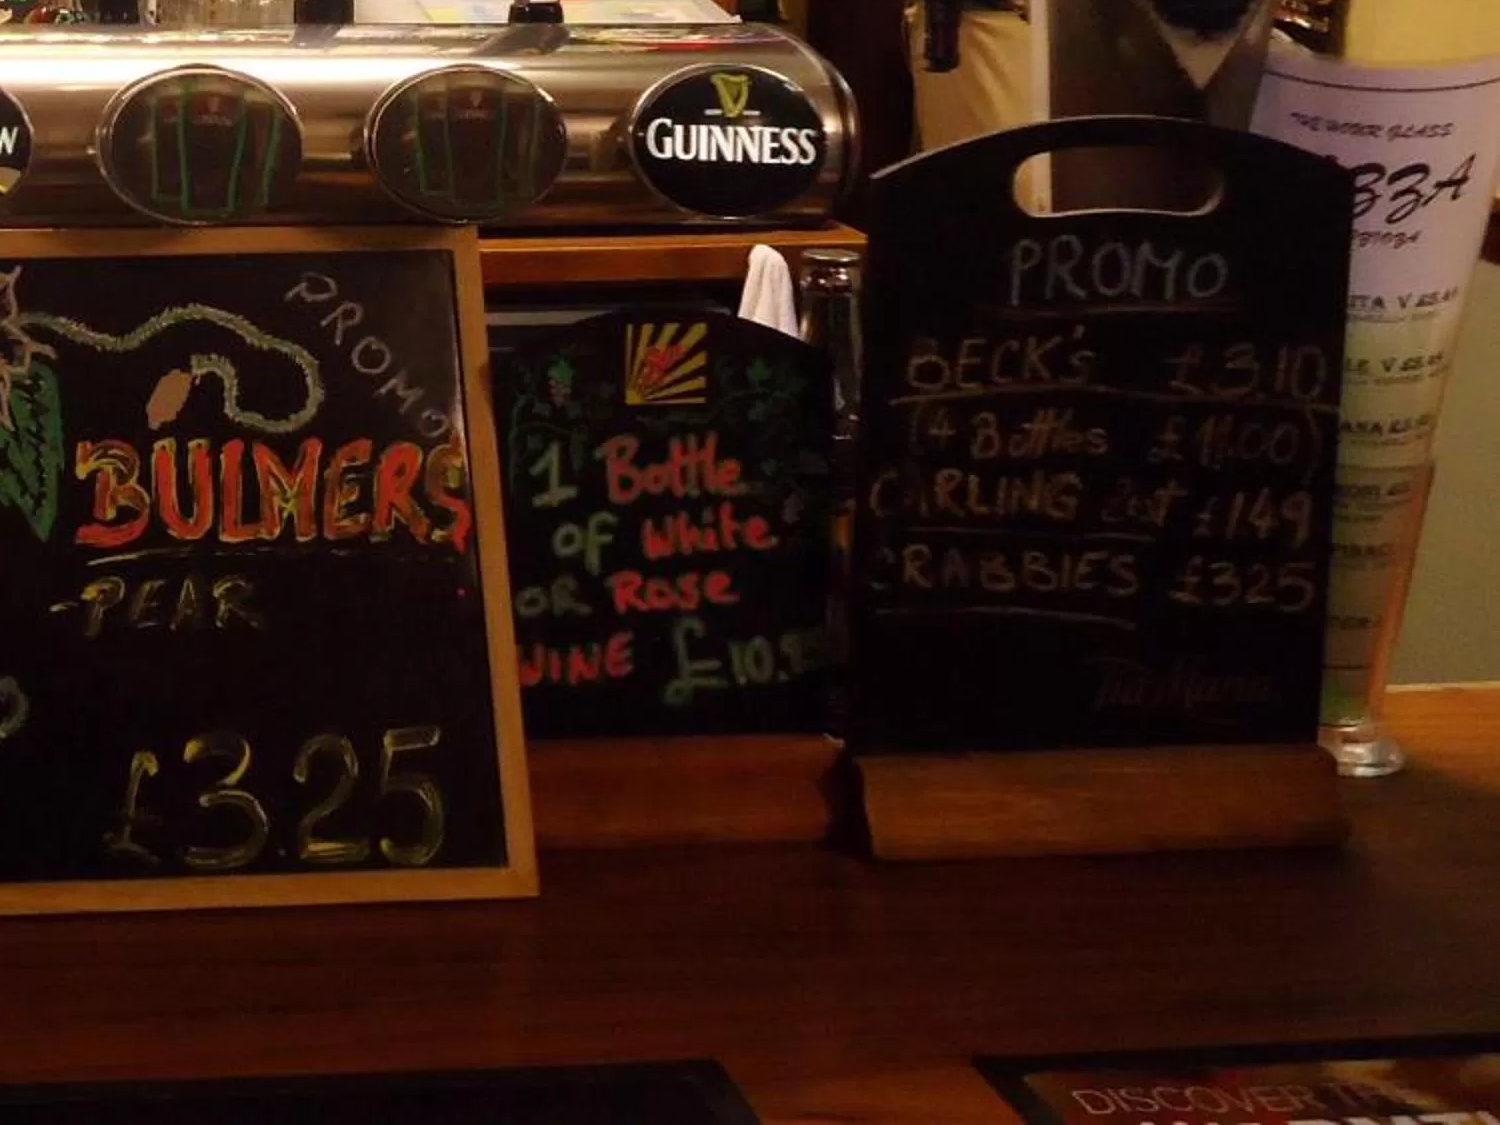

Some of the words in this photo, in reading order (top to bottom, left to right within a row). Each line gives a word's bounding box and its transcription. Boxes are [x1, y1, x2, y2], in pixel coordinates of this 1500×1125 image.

[645, 116, 817, 166] GUINNESS
[1008, 233, 1230, 307] PROMO
[285, 272, 451, 439] PROMO
[74, 433, 473, 552] BULMERS
[594, 430, 746, 505] Bottle
[639, 500, 781, 561] White
[1071, 1083, 1321, 1116] DISCOVER
